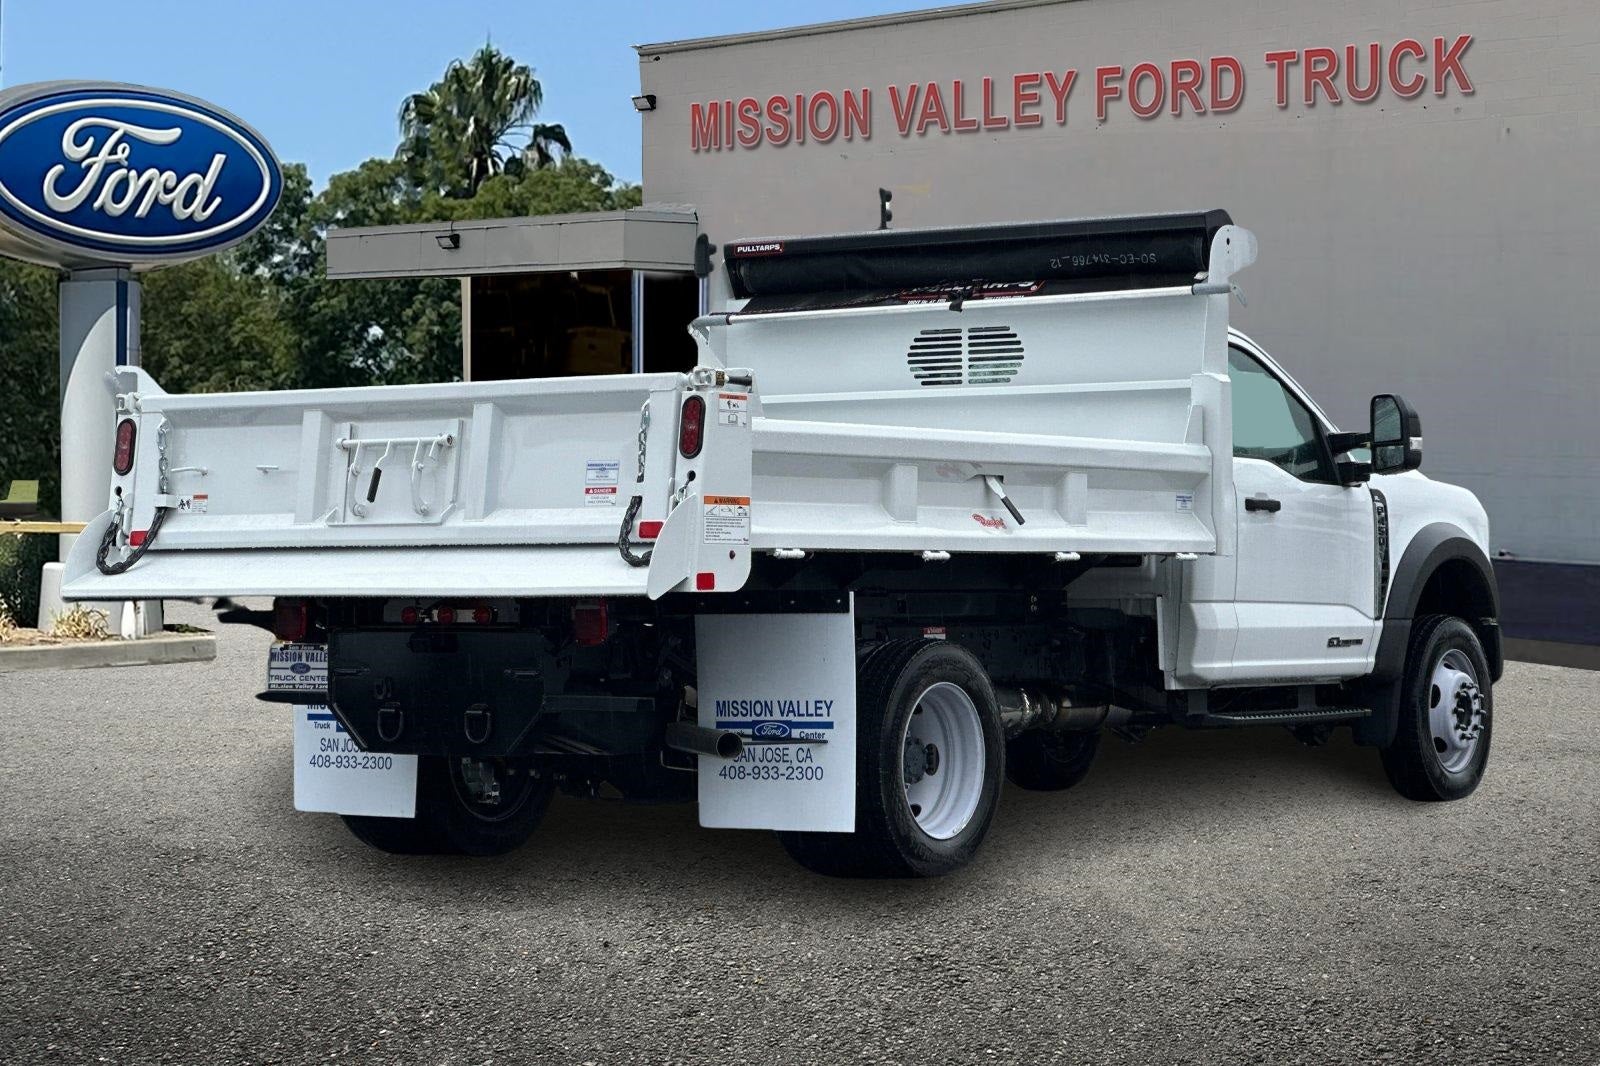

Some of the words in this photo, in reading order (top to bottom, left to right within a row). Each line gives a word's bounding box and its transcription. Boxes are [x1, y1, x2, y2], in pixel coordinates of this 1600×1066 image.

[690, 87, 871, 150] MISSION
[887, 68, 1078, 136] VALLEY
[1095, 54, 1244, 120] FORD
[1263, 33, 1474, 107] TRUCK
[43, 117, 227, 223] Ford
[737, 244, 780, 252] PULLTARPS
[271, 652, 303, 662] MISSION
[305, 652, 328, 662] VALLE
[716, 700, 773, 717] MISSION
[778, 700, 834, 717] VALLEY
[314, 721, 331, 729] Truck
[761, 725, 783, 737] Ford
[799, 730, 826, 739] Center
[320, 738, 339, 752] SAN
[309, 754, 393, 770] 408-933-2300
[759, 747, 793, 765] JOSE,
[796, 747, 813, 763] CA
[719, 765, 824, 780] 408-933-2300
